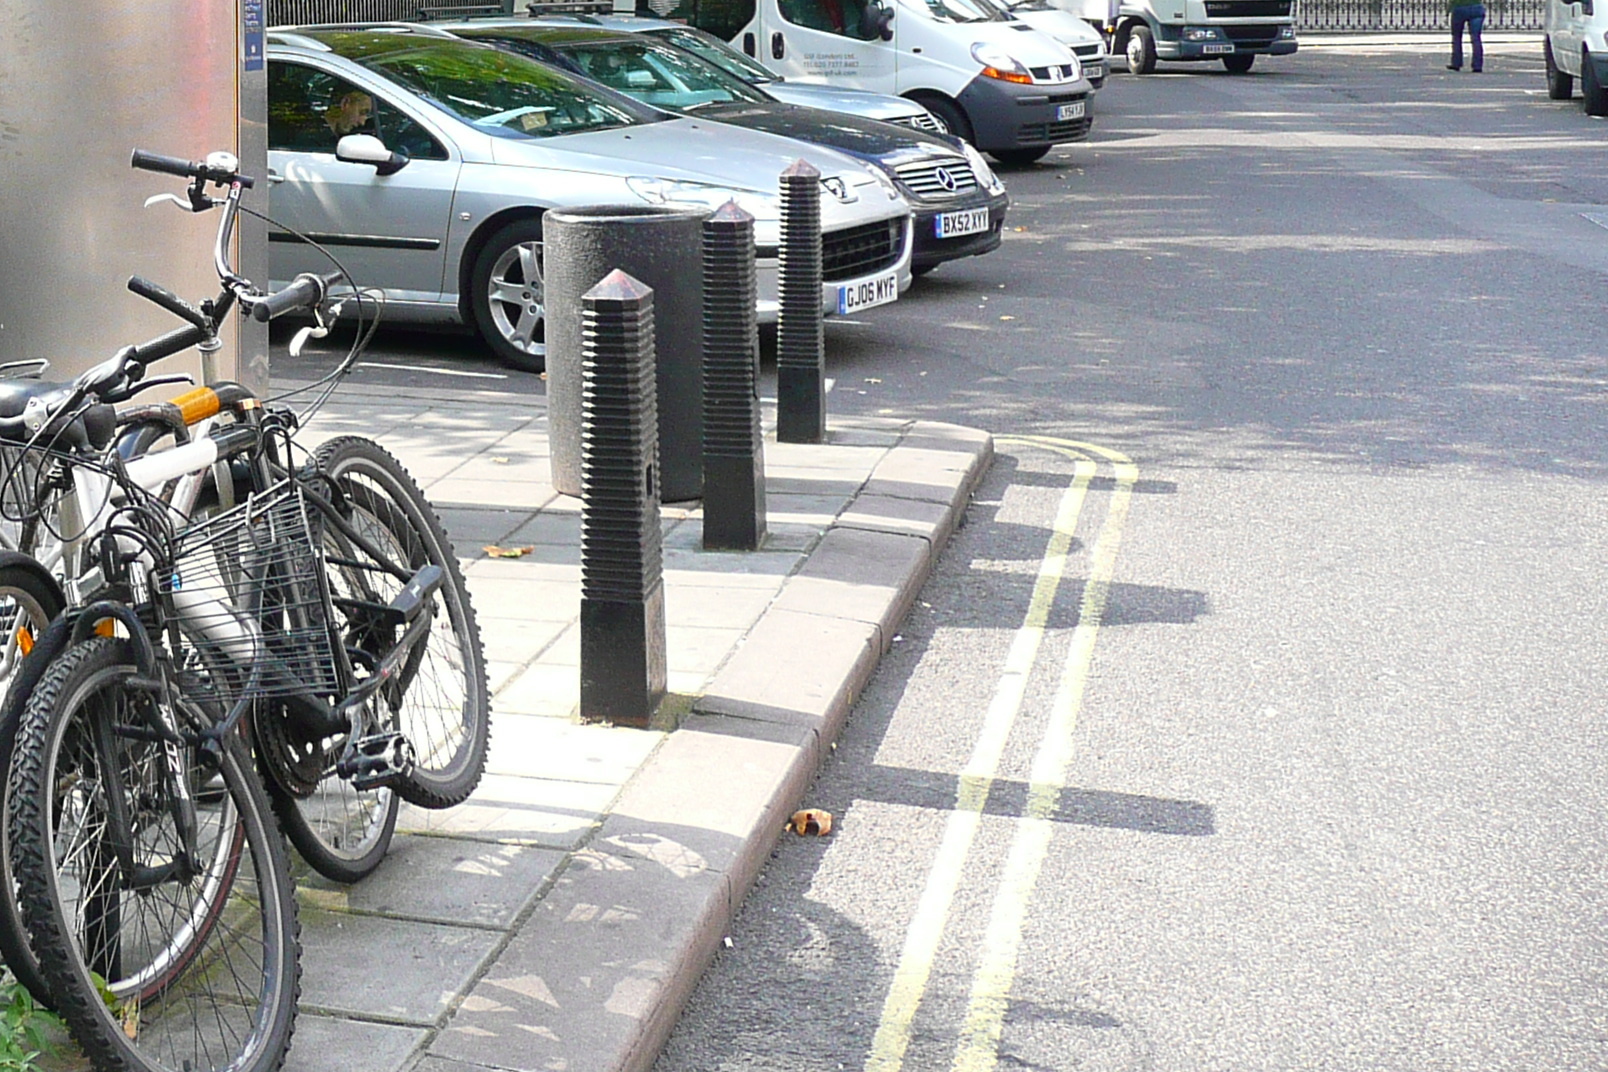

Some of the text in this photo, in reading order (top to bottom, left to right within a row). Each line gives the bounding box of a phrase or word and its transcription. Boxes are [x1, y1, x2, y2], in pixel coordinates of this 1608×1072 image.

[943, 211, 987, 234] BX52 XYY
[847, 276, 895, 308] GJ06 MYF
